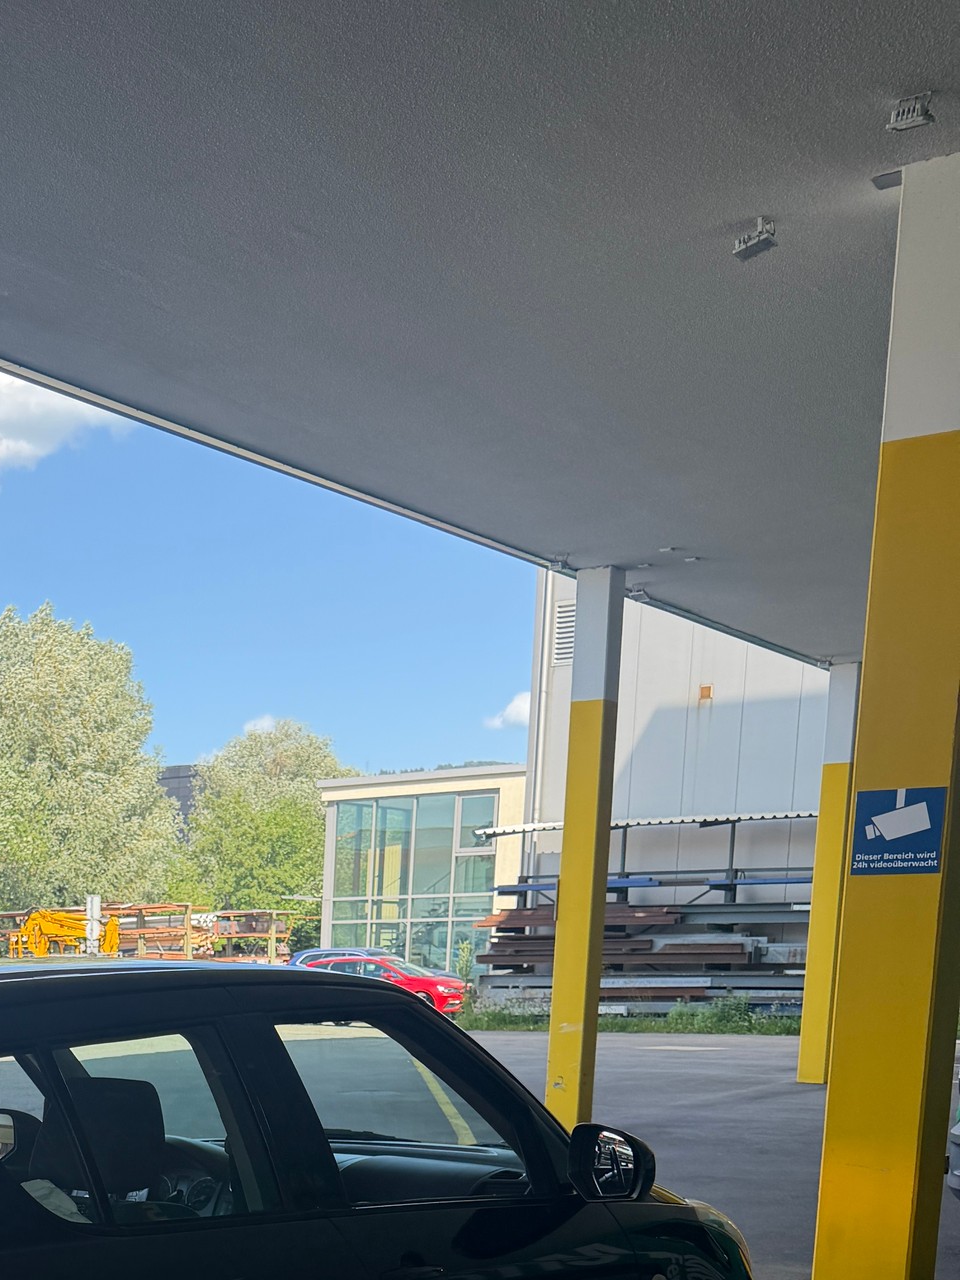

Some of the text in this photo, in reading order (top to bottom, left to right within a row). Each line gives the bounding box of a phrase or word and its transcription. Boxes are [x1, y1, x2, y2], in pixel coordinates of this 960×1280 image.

[855, 850, 937, 861] Dieser Bereich wird
[852, 859, 938, 869] 24h videoüberwacht
